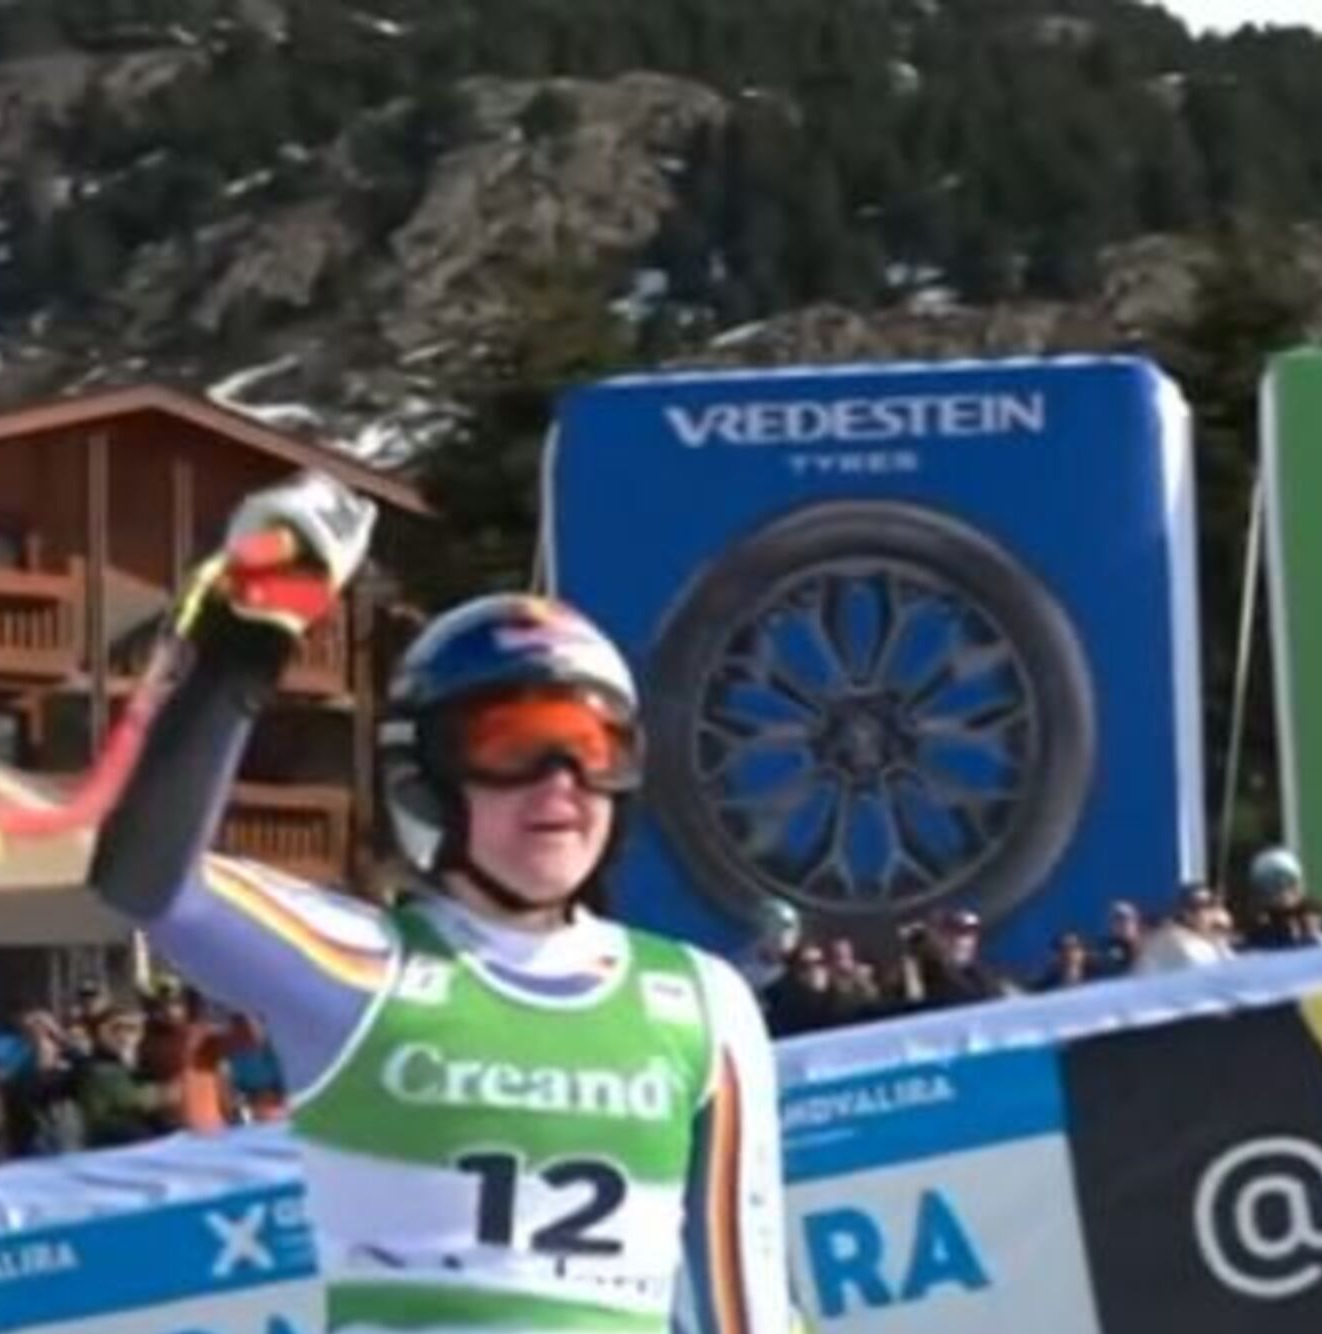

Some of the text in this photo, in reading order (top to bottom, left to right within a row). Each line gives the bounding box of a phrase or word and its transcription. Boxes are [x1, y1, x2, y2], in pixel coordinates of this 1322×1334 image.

[663, 392, 1047, 448] VREDESTEIN
[381, 1042, 679, 1120] Creand
[456, 1150, 631, 1257] 12
